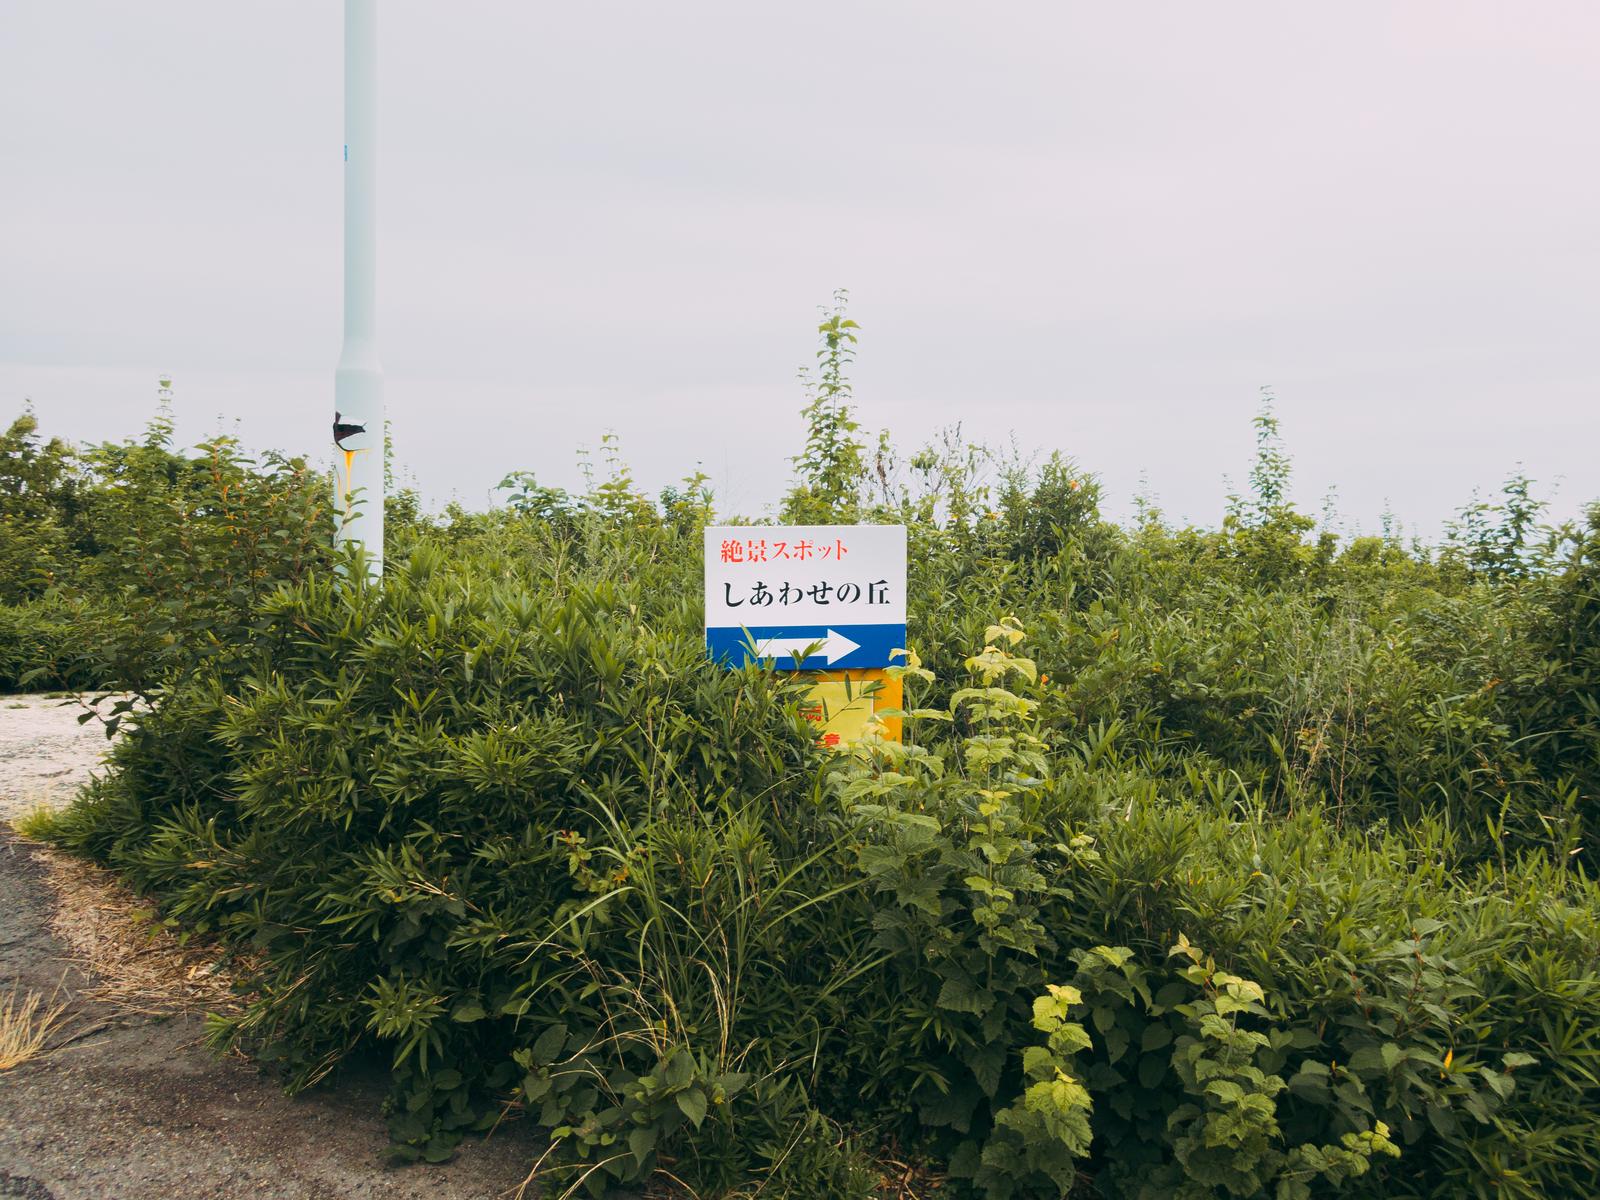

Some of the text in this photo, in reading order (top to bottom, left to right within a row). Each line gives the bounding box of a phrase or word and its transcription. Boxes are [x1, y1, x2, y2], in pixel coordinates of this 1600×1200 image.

[720, 539, 848, 563] 絶景スポット
[723, 579, 891, 608] しあわせの丘
